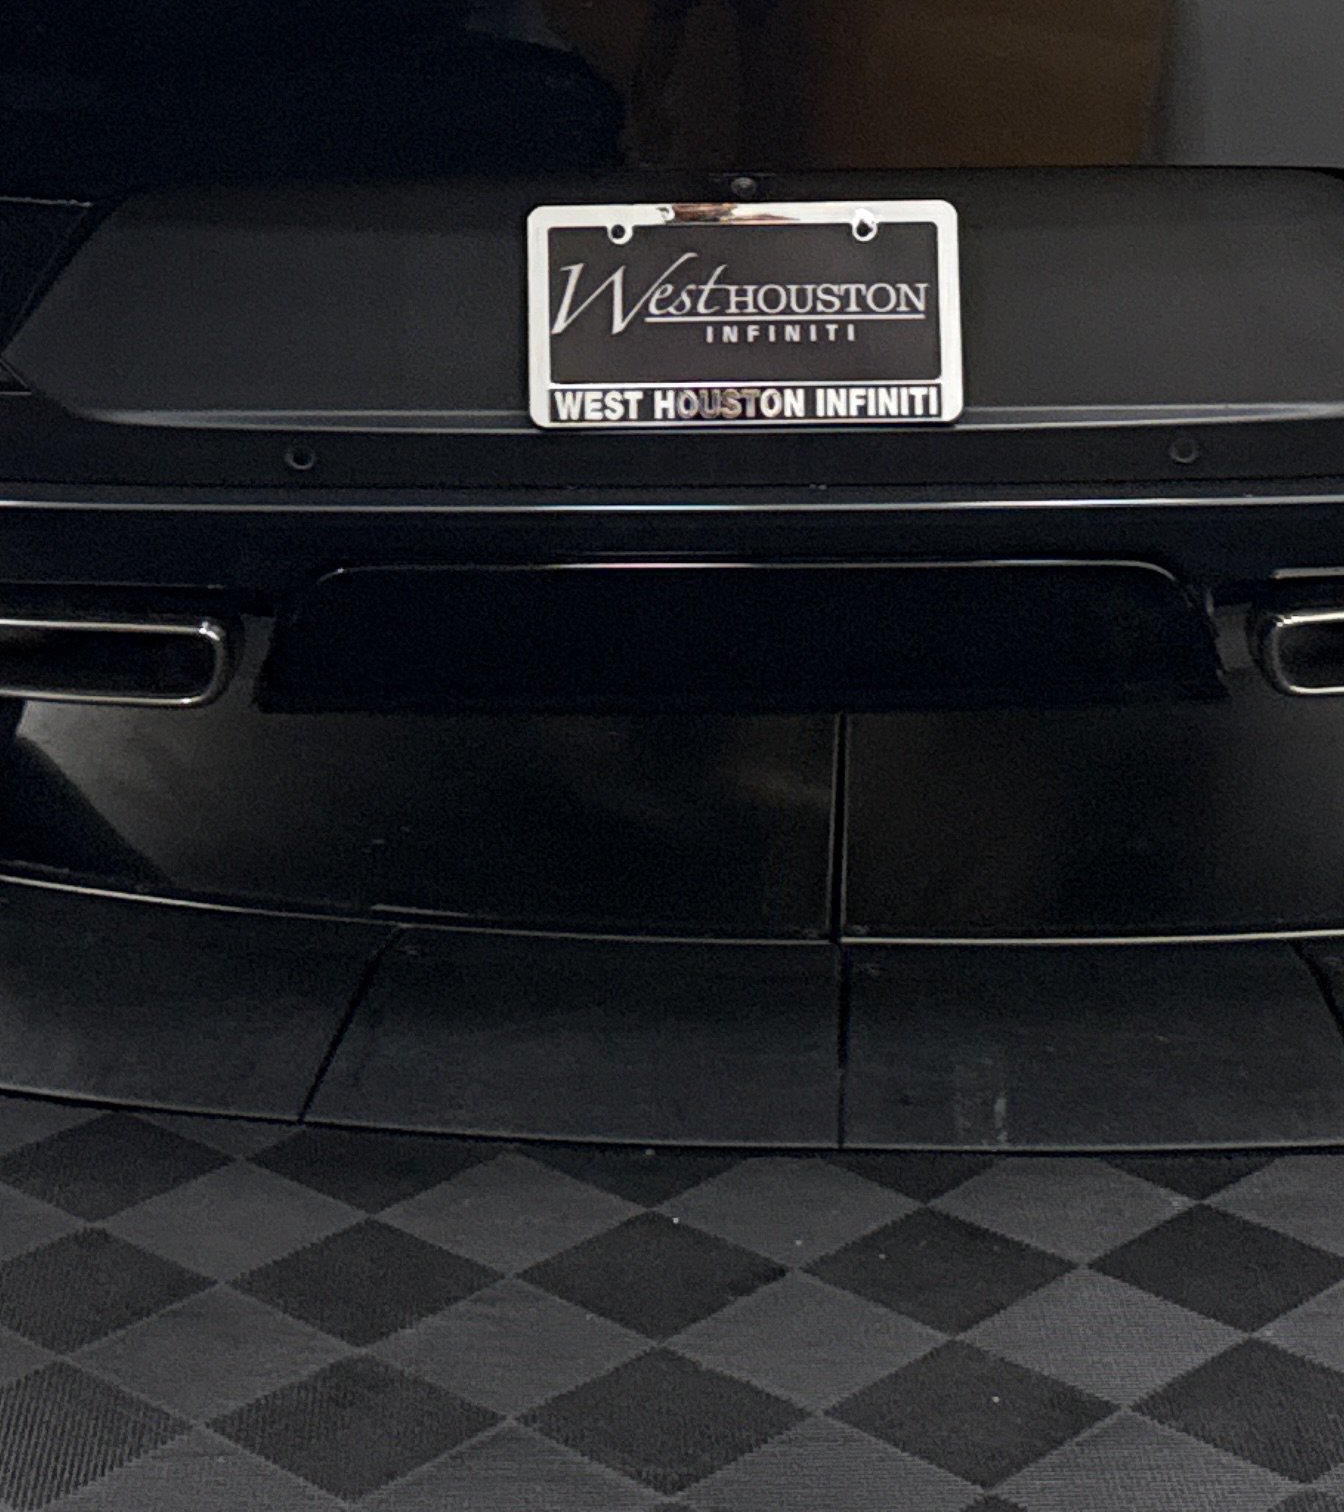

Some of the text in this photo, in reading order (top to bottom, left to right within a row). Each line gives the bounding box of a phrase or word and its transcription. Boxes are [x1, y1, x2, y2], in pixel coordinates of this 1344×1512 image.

[551, 252, 929, 335] West HOUSTON
[705, 324, 856, 343] INFINITI
[555, 386, 939, 420] WEST HOUSTON INFINITI
